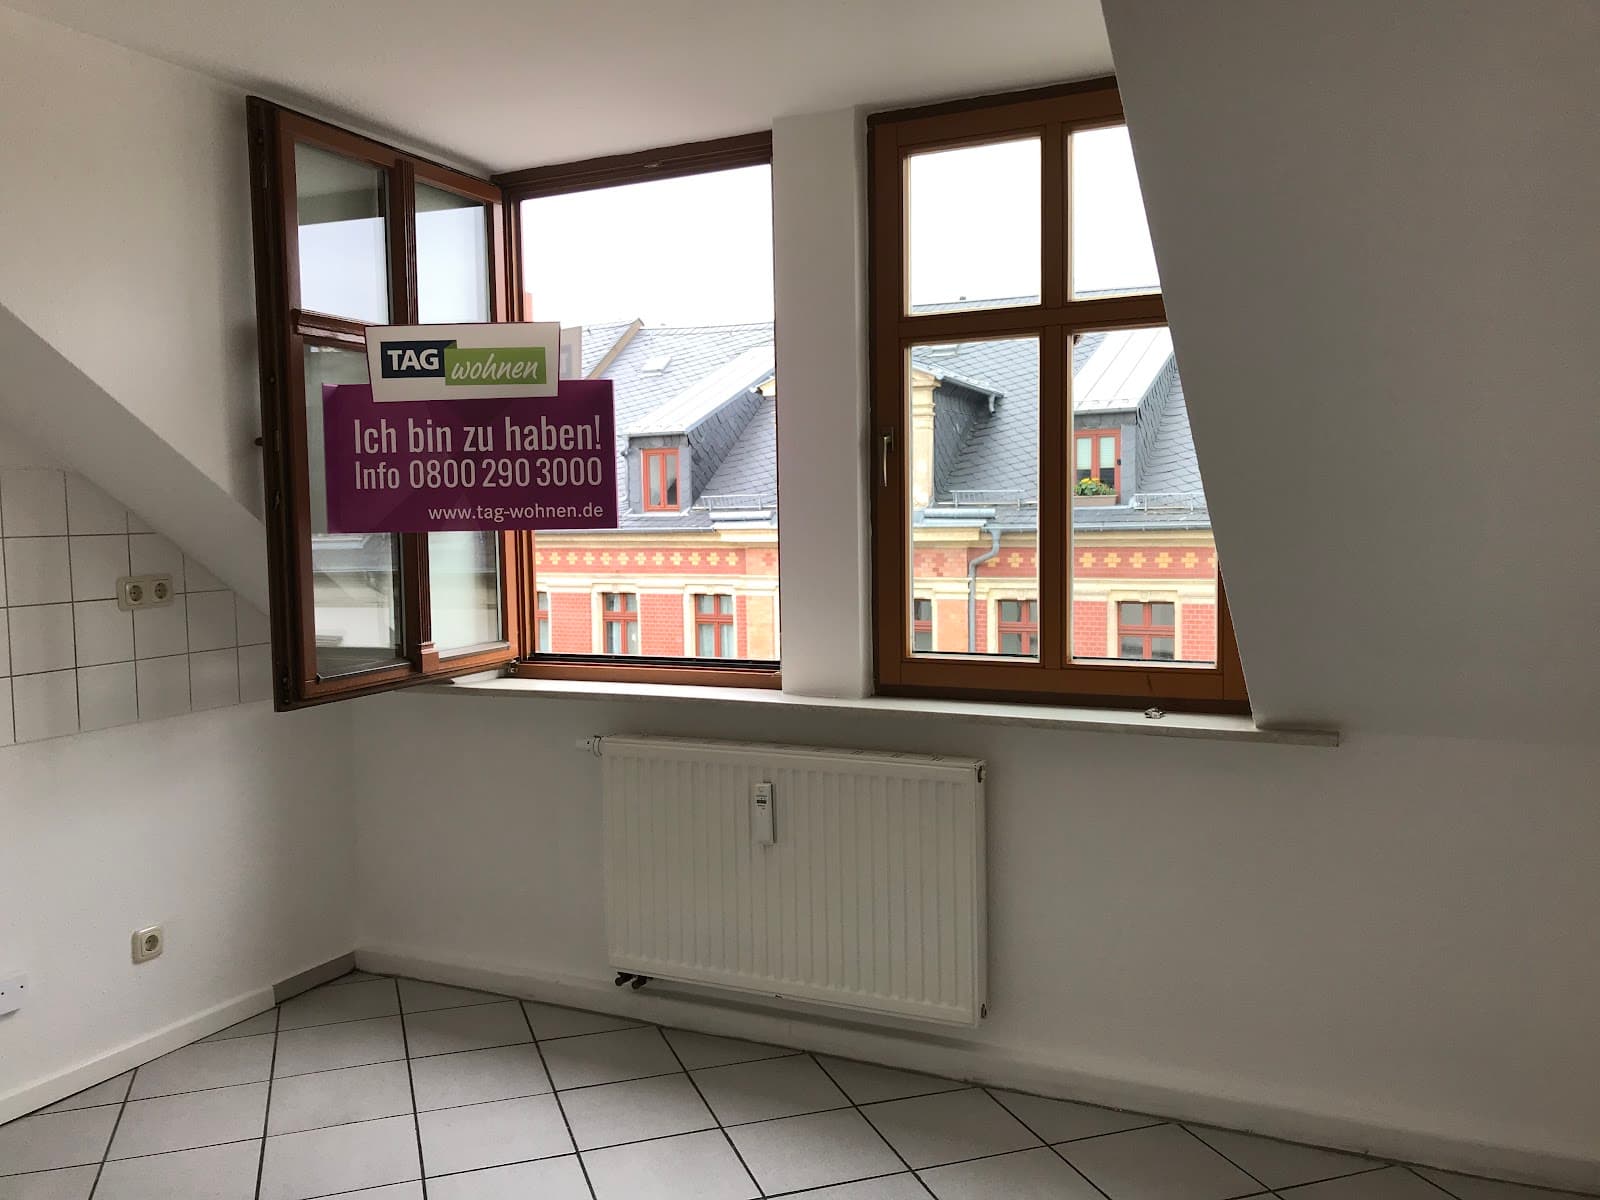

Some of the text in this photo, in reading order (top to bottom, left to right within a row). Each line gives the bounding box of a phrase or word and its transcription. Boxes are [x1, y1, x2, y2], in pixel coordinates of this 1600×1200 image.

[387, 348, 537, 381] TAG wohnen
[354, 414, 601, 455] Ich bin zu haben!
[355, 457, 602, 490] Info 0800 290 3000
[428, 502, 604, 523] www.tag-wohnen.de
